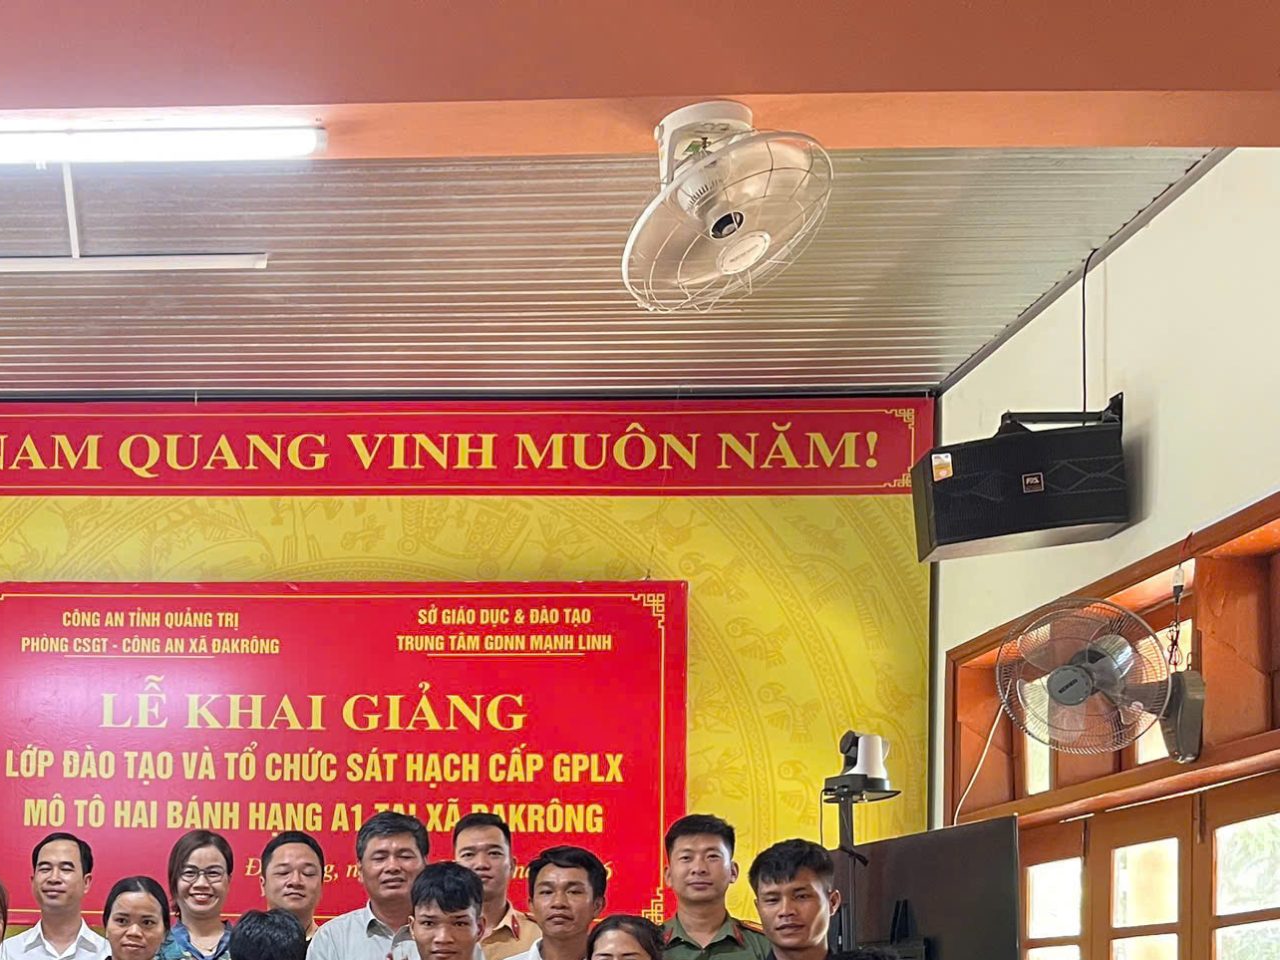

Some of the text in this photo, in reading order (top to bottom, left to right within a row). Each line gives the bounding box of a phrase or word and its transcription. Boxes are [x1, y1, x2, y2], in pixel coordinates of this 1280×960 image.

[119, 432, 330, 479] QUANG
[349, 433, 497, 472] VINH
[514, 422, 700, 472] MUÔN
[717, 421, 881, 470] NĂM!
[62, 606, 239, 631] CÔNG AN TỈNH QUẢNG TRỊ
[417, 603, 592, 627] SỞ GIÁO DỤC & ĐÀO TẠO
[21, 633, 69, 653] PHÒNG
[73, 637, 109, 653] CSGT
[122, 635, 161, 653] CÔNG
[164, 637, 185, 653] AN
[188, 635, 208, 653] XÃ
[211, 635, 280, 654] ĐAKRÔNG
[396, 632, 612, 654] TRUNG TÂM GDNN MẠNH LINH
[98, 675, 528, 733] LỄ KHAI GIẢNG
[5, 741, 624, 788] LỚP ĐÀO TẠO VÀ TỔ CHỨC SÁT HẠCH CẤP GPLX
[23, 793, 66, 827] MÔ
[73, 794, 105, 828] TÔ
[114, 800, 158, 828] HAI
[166, 795, 240, 831] BÁNH
[248, 801, 323, 836] HẠNG
[330, 803, 362, 832] A1
[426, 798, 461, 832] XÃ
